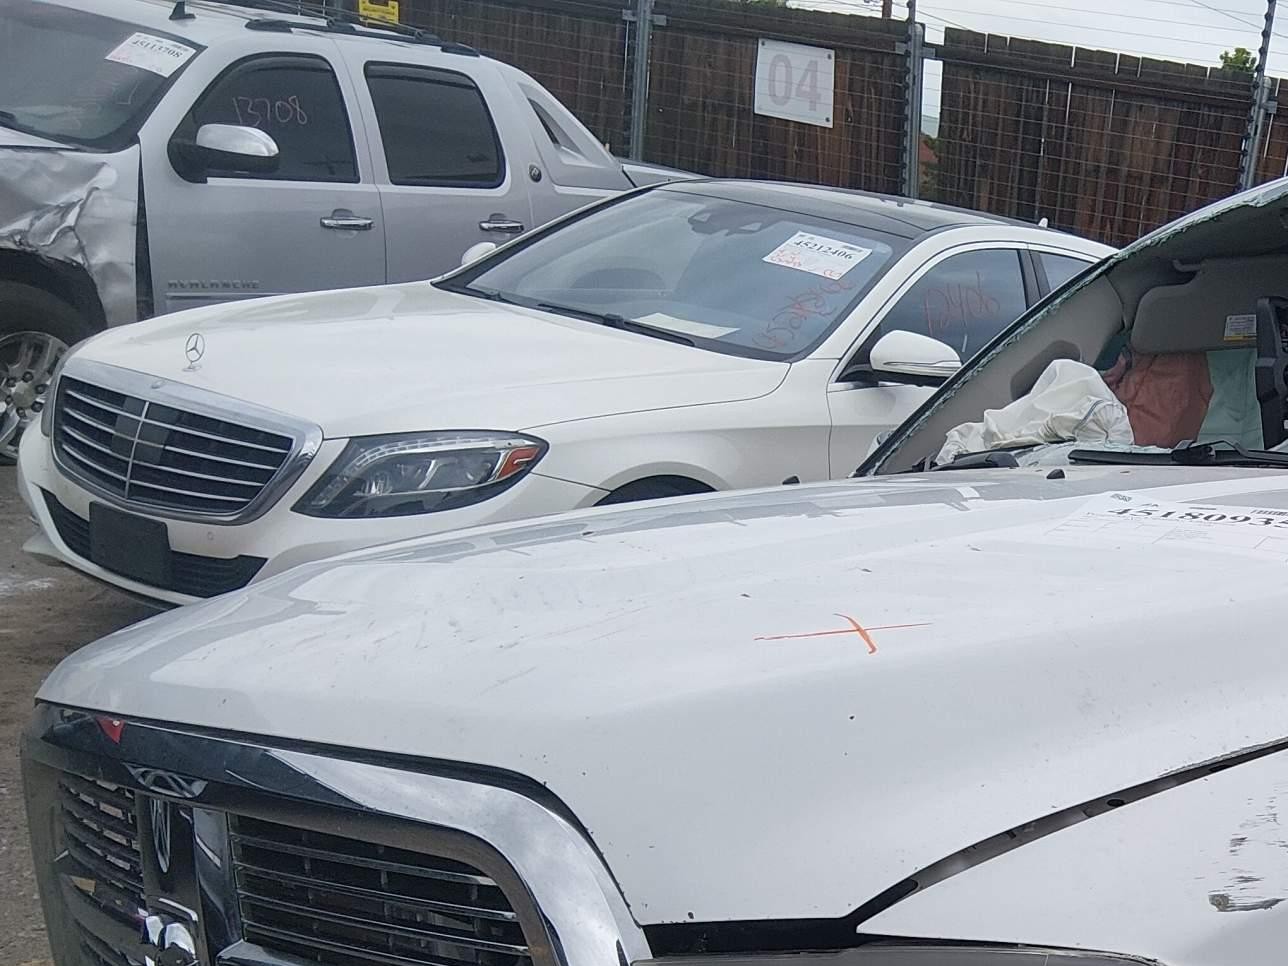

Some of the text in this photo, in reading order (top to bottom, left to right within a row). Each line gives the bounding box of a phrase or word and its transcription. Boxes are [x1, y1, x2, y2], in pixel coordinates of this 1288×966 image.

[767, 53, 822, 112] 04
[232, 95, 308, 126] 13708
[793, 240, 854, 260] 45212406
